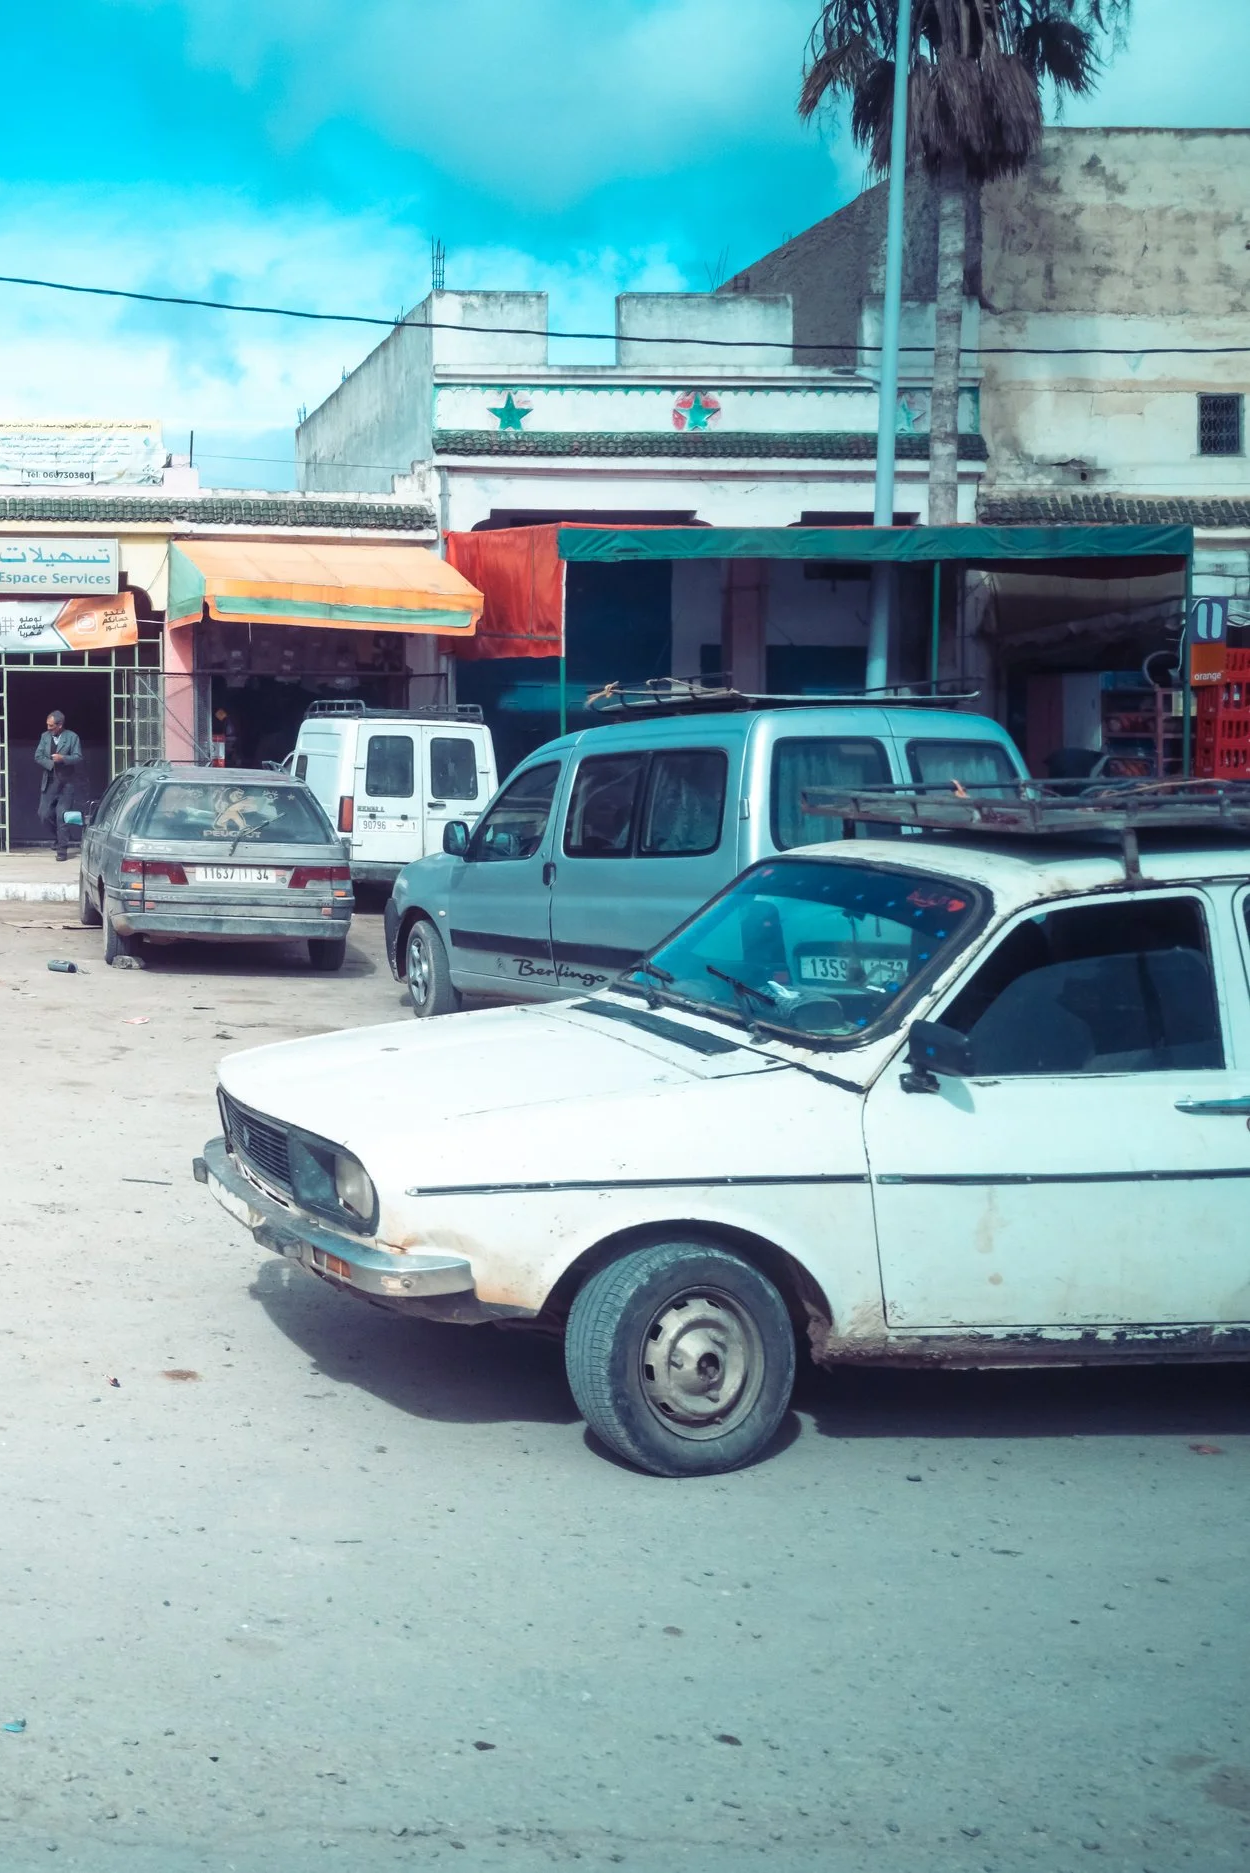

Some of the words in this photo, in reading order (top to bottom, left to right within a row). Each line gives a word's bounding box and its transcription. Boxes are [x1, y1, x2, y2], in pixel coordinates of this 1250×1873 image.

[0, 547, 110, 567] تسهيلات
[52, 573, 111, 585] Services
[1194, 672, 1222, 682] orange
[363, 820, 386, 830] 90796
[204, 867, 235, 880] 11637
[513, 959, 608, 987] Berlingo
